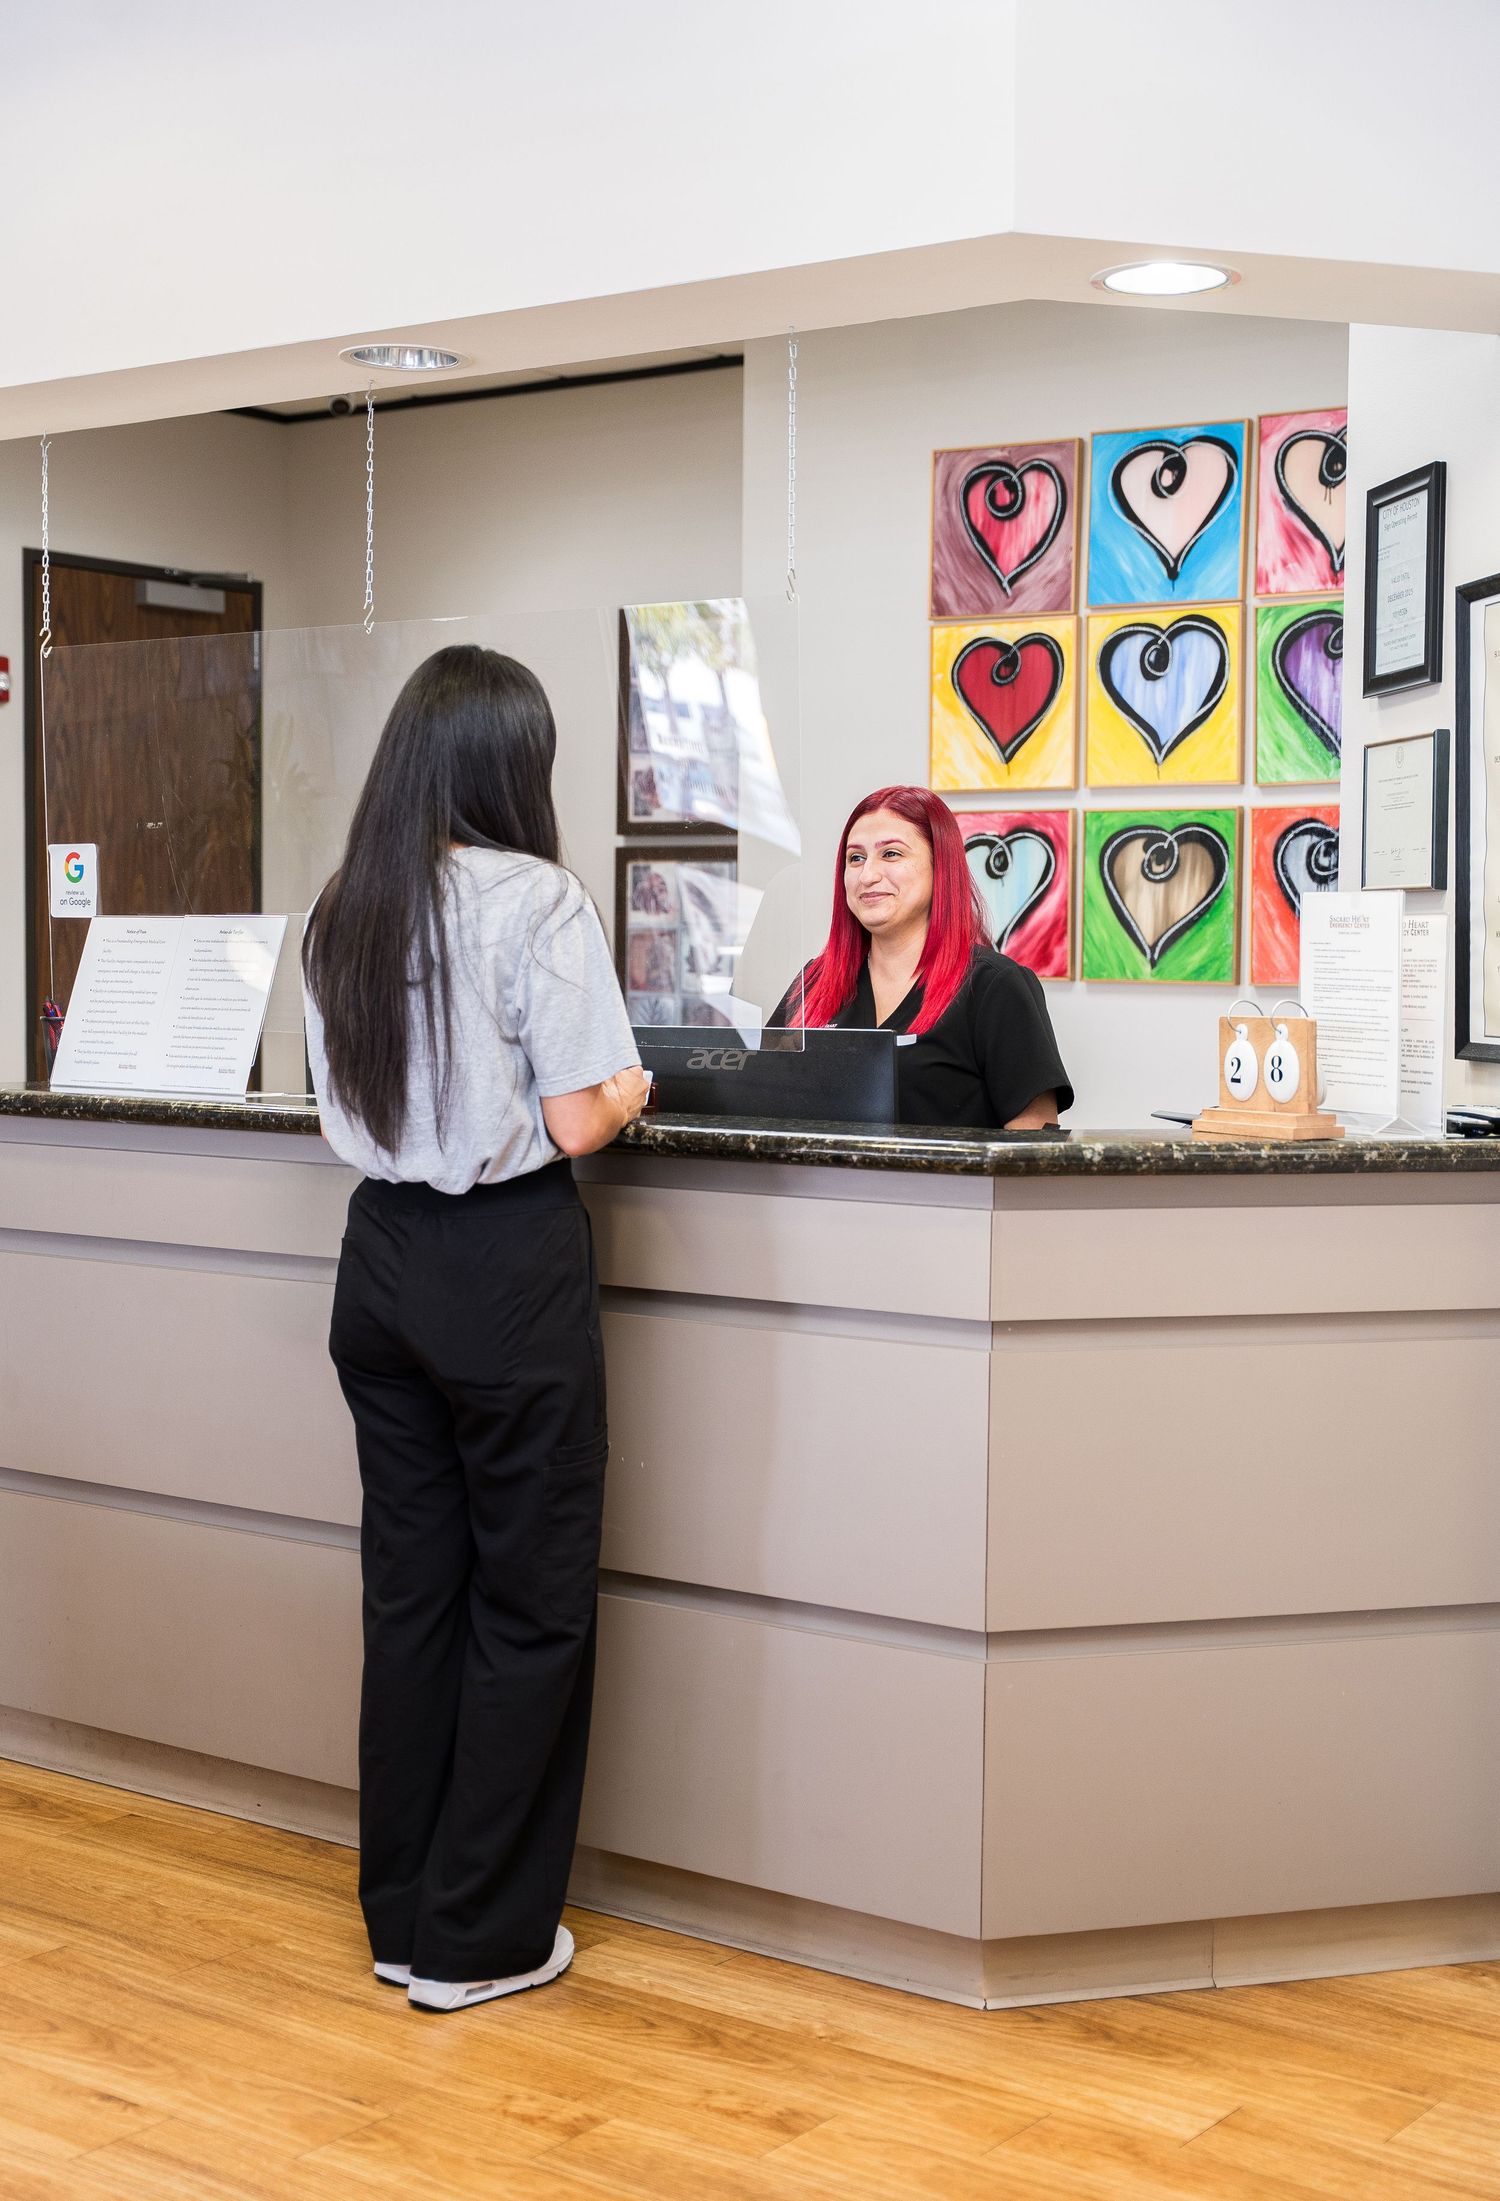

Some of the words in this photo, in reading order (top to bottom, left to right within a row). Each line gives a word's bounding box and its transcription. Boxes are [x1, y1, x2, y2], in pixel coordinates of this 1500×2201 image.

[1383, 508, 1392, 519] CITY
[1393, 504, 1399, 515] OF
[1399, 497, 1420, 512] HOUSTON
[60, 898, 68, 906] on
[69, 897, 91, 908] Google
[1408, 919, 1430, 929] HEART
[1411, 928, 1429, 936] CENTER
[686, 1049, 757, 1071] acer
[1230, 1056, 1242, 1084] 2
[1270, 1055, 1283, 1083] 8
